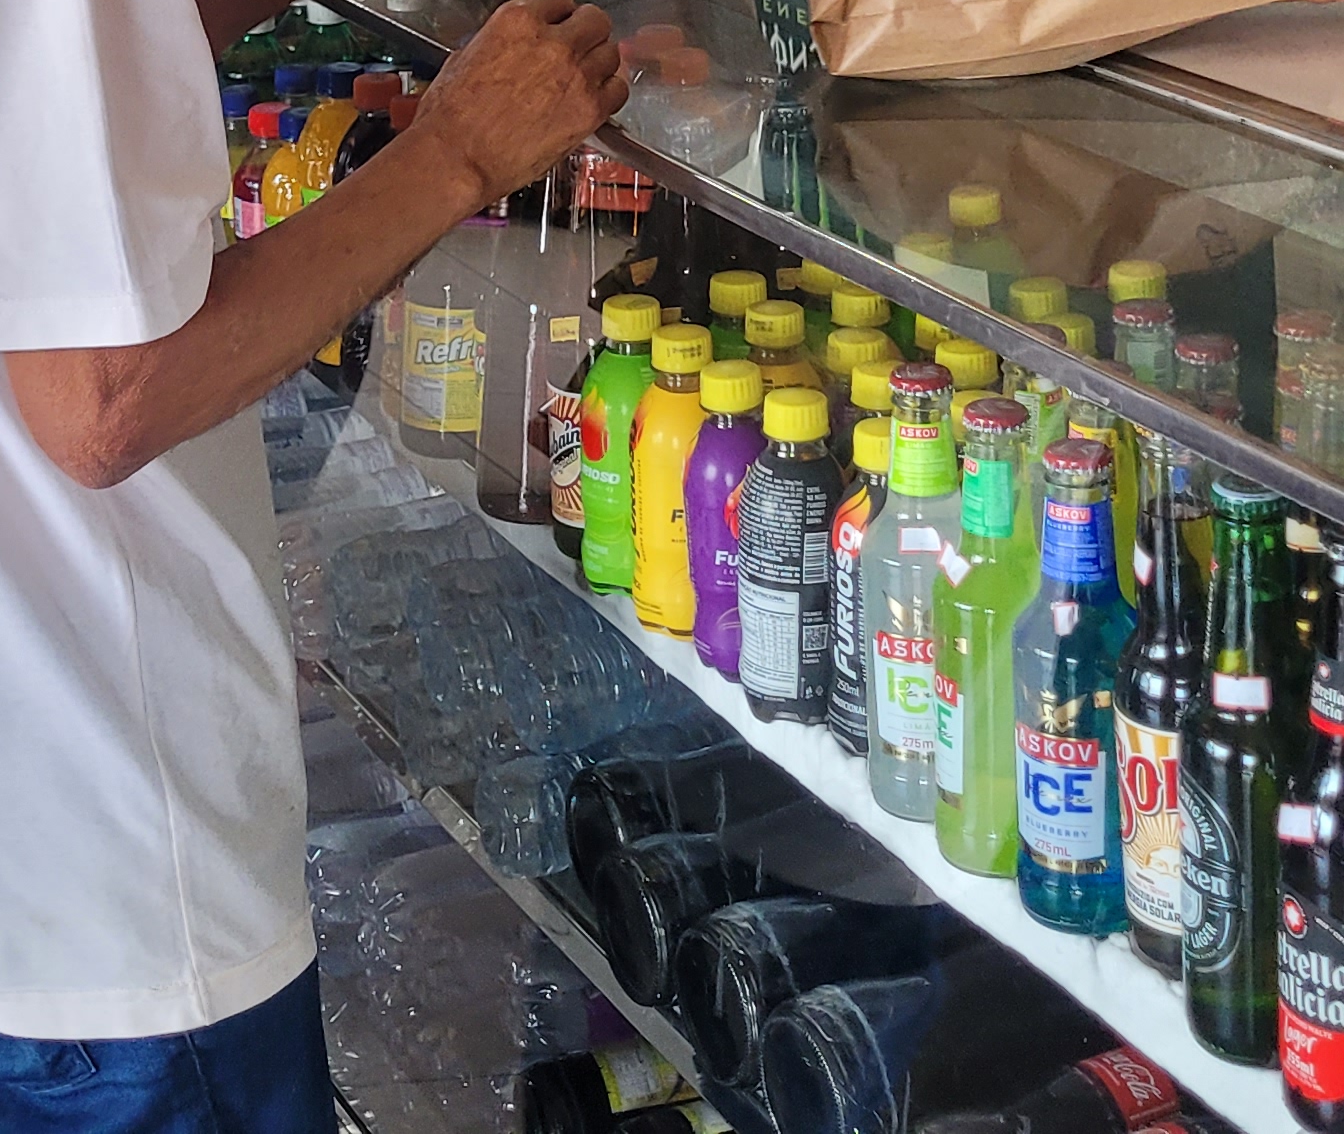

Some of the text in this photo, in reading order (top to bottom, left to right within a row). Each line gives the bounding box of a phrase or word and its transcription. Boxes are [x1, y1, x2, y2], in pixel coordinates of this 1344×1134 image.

[900, 426, 937, 438] ASKOV
[1049, 505, 1087, 520] ASKOV
[834, 521, 857, 681] FURIOSO
[880, 636, 936, 660] ASK
[901, 736, 935, 749] 275m
[1017, 727, 1093, 764] ASKOV
[1023, 759, 1093, 817] ICE
[1025, 814, 1089, 839] BLUEBERRY
[1034, 836, 1072, 858] 275mL
[1156, 895, 1175, 910] COM
[1190, 921, 1218, 950] LAGER
[1283, 1014, 1319, 1056] Lager
